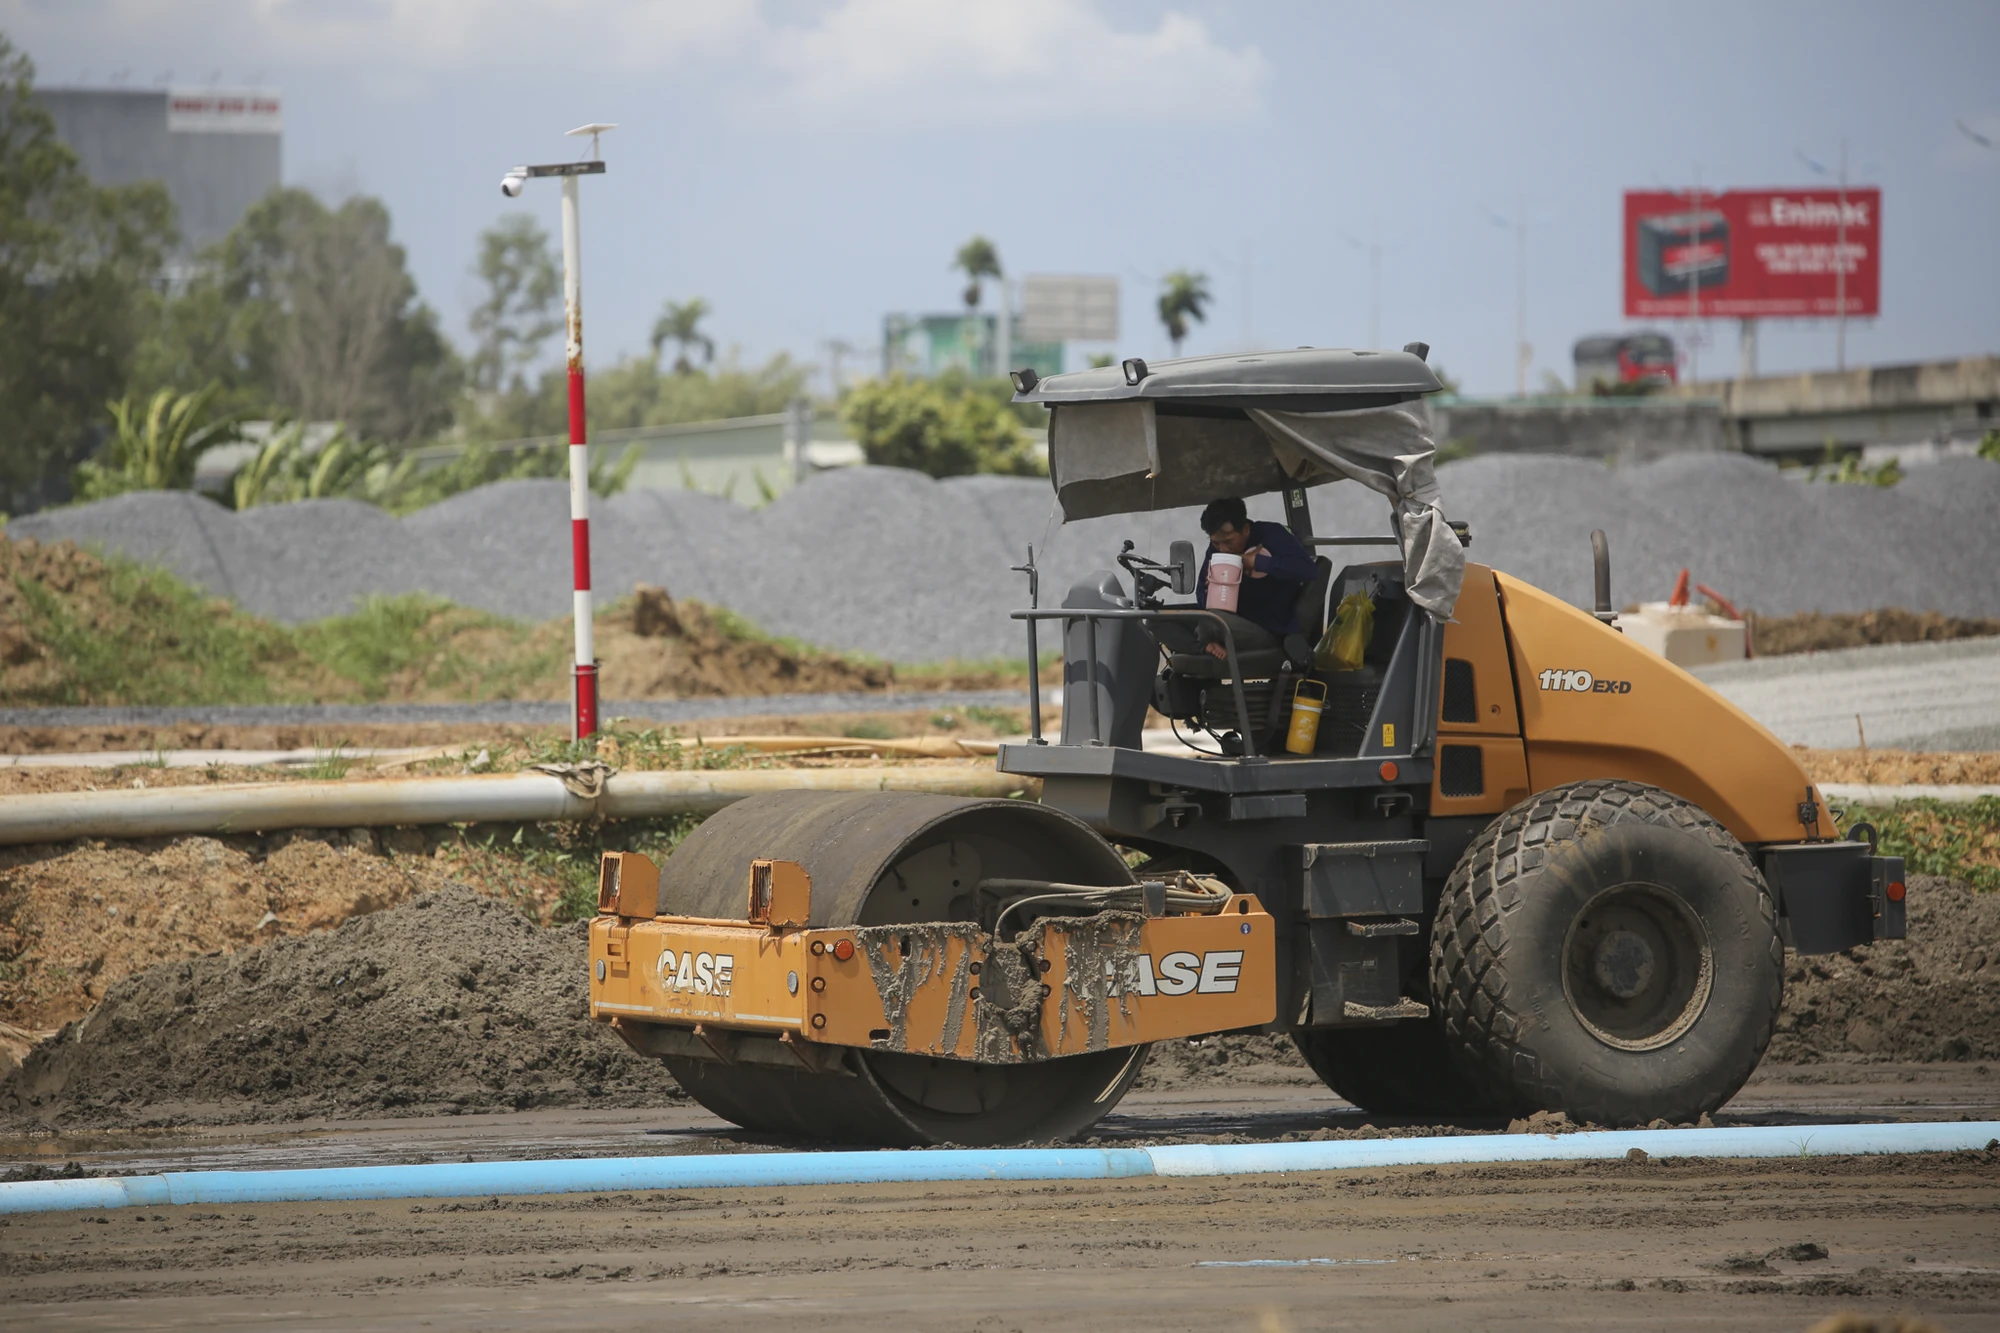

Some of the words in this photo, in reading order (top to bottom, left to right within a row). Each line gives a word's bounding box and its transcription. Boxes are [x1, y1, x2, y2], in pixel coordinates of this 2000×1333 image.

[1538, 668, 1593, 692] 1110
[1592, 680, 1632, 694] EX-D
[656, 948, 734, 997] CASE
[1070, 950, 1244, 998] ASE
